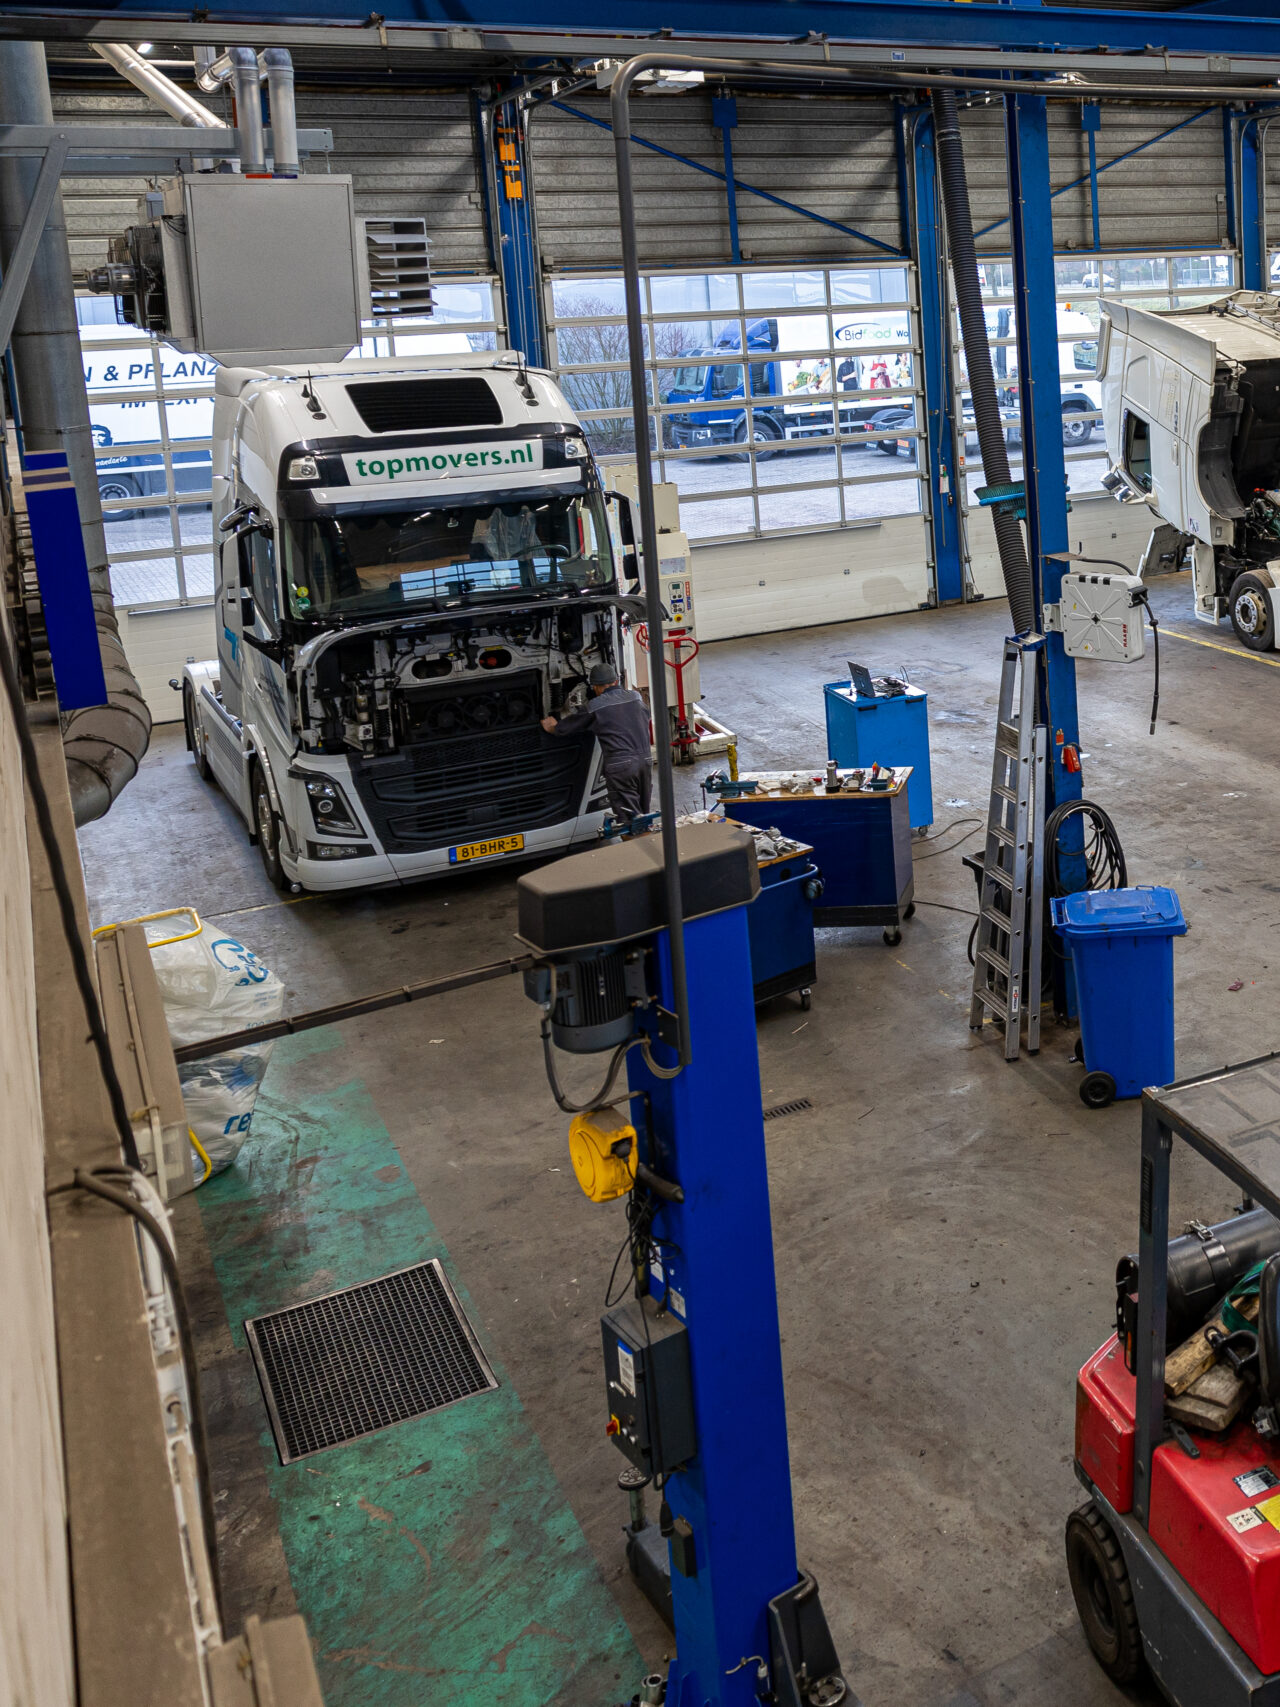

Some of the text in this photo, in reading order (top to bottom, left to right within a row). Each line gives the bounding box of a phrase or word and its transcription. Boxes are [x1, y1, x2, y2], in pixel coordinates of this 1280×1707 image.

[844, 327, 892, 341] Bidfood
[103, 365, 119, 382] &
[355, 443, 534, 479] topmovers.nl
[461, 837, 519, 858] 81-BHR-5
